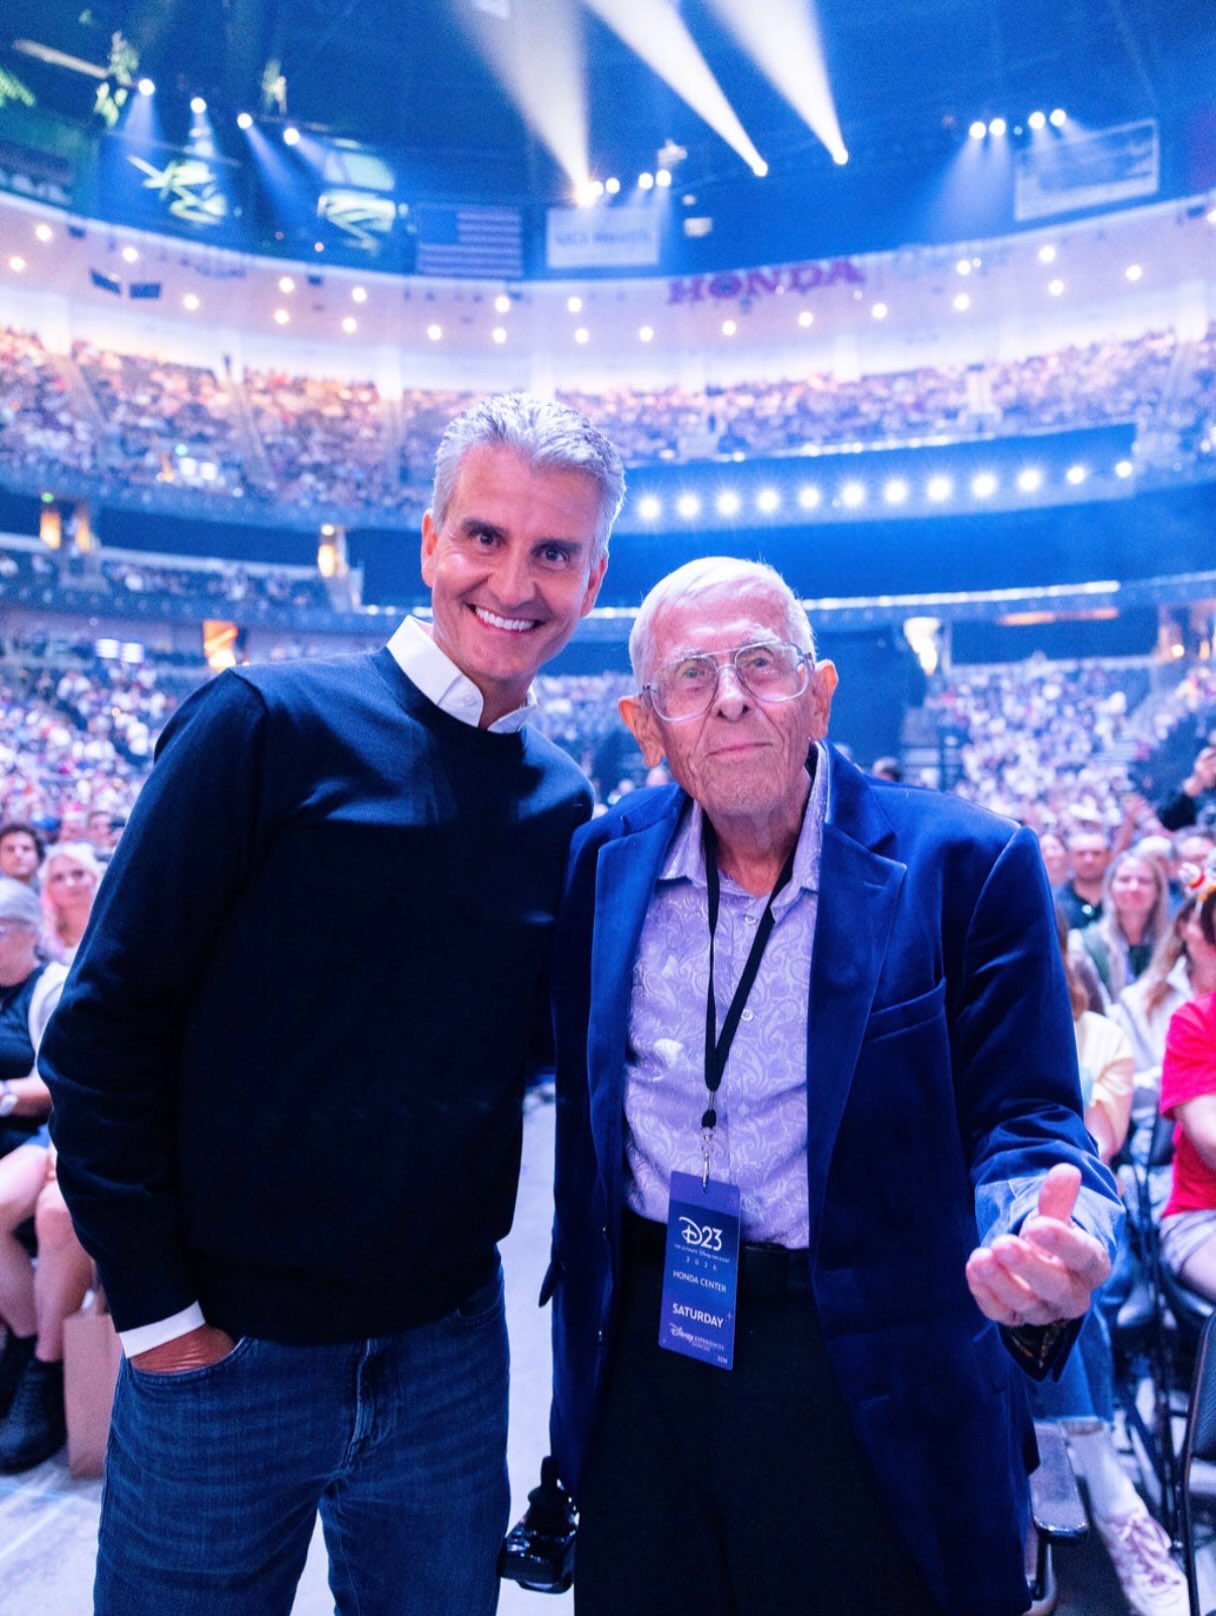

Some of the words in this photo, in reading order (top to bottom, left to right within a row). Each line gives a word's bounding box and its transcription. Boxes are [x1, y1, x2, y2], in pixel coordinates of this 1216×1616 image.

[667, 258, 865, 305] HONDA
[679, 1216, 723, 1252] D23
[672, 1270, 699, 1285] HONDA
[700, 1278, 727, 1292] CENTER
[672, 1303, 724, 1328] SATURDAY
[669, 1322, 694, 1343] Disney
